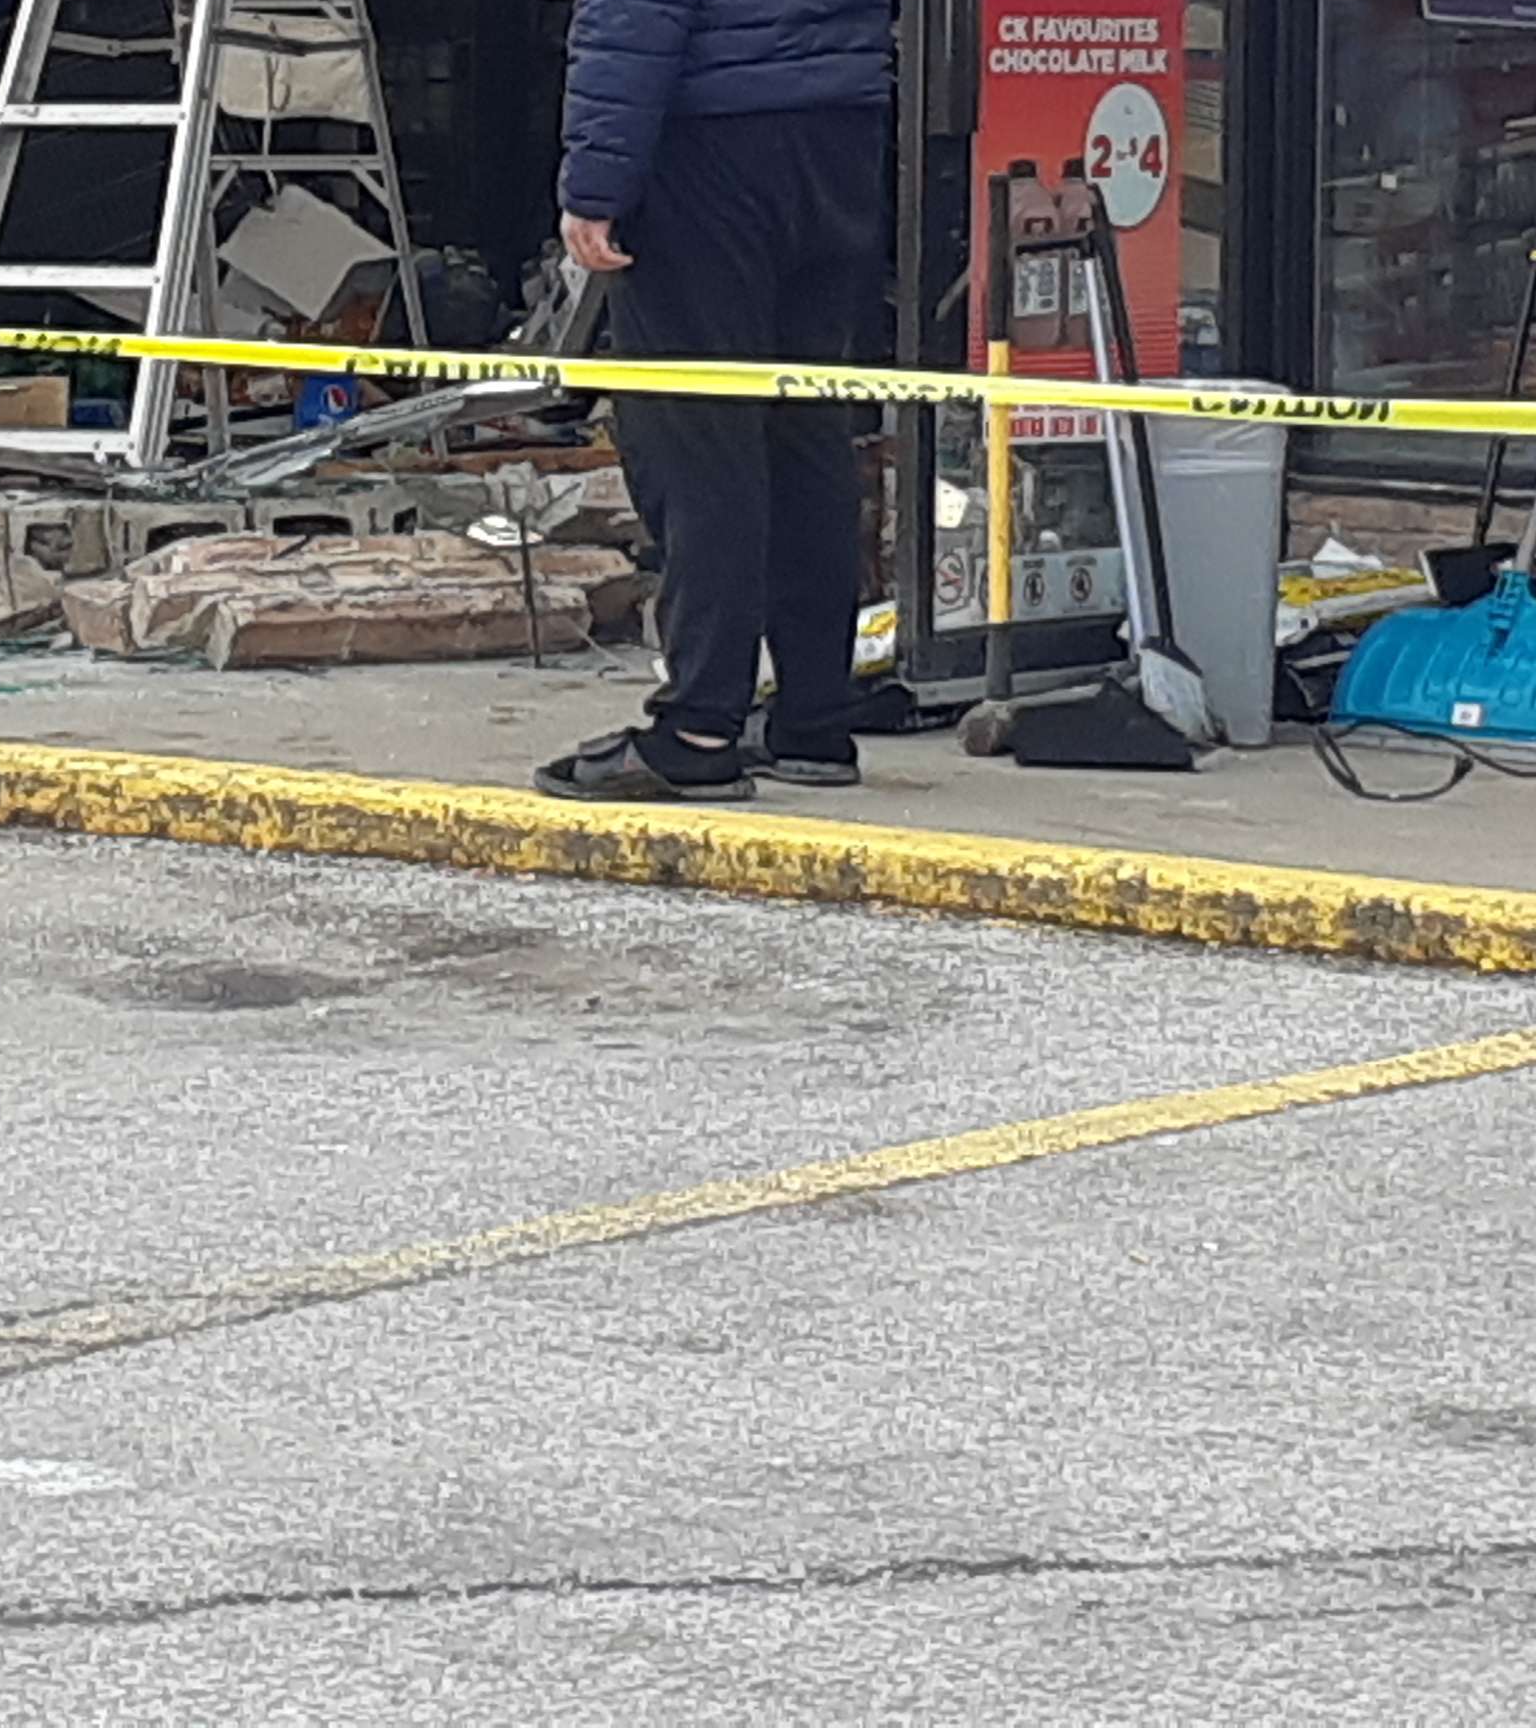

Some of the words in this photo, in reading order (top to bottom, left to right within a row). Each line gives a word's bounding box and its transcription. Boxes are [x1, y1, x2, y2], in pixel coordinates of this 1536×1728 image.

[998, 14, 1029, 44] CK
[1032, 14, 1159, 44] FAVOURITES
[988, 47, 1115, 74] CHOCOLATE
[1118, 48, 1168, 74] MILK
